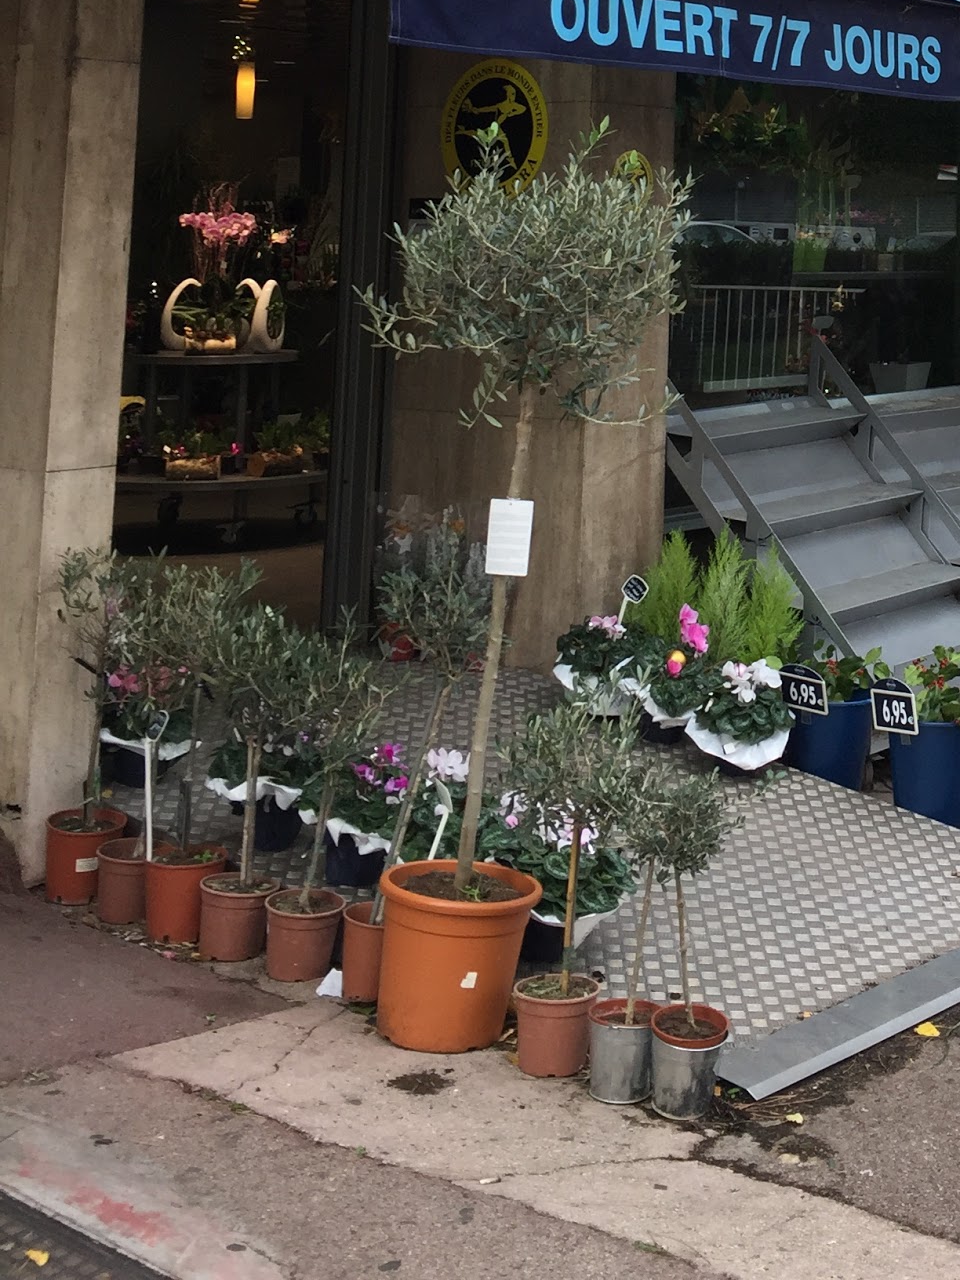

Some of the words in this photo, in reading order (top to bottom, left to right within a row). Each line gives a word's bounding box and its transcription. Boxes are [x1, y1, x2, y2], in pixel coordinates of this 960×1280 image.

[749, 14, 812, 71] 7/7
[824, 23, 942, 84] JOURS
[494, 65, 507, 74] LE
[507, 67, 534, 97] MONDE
[531, 96, 544, 139] ENTIER
